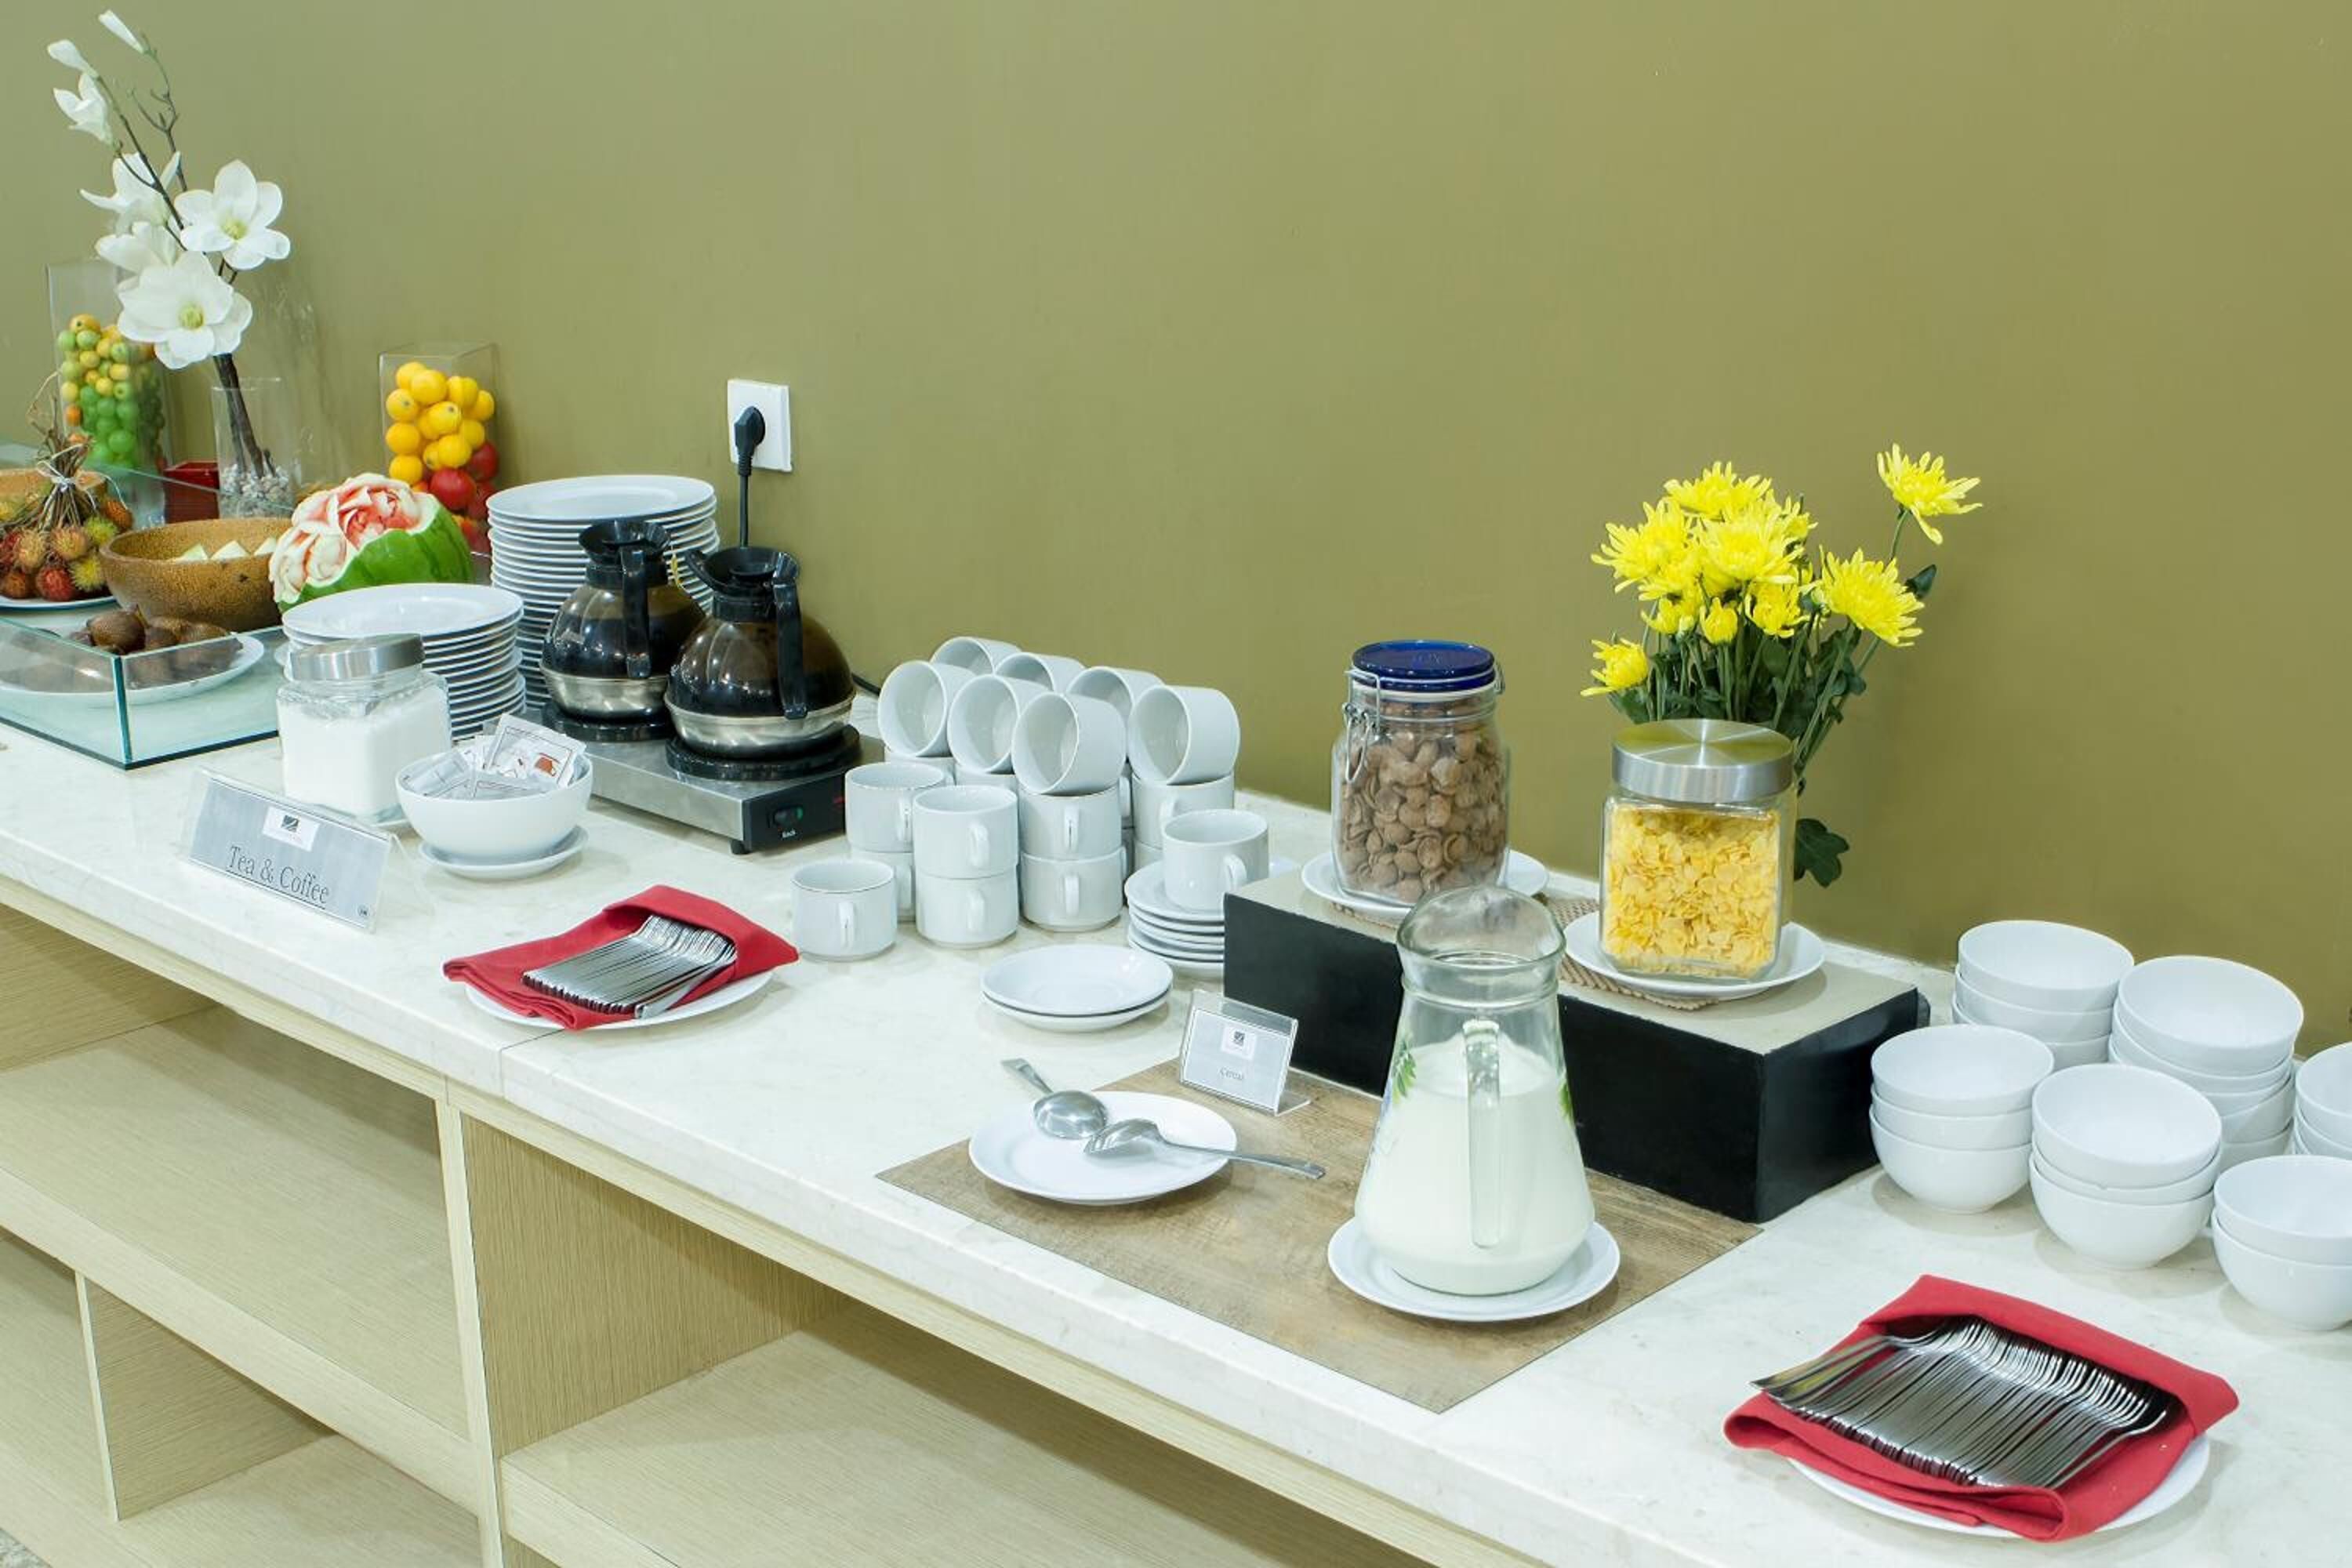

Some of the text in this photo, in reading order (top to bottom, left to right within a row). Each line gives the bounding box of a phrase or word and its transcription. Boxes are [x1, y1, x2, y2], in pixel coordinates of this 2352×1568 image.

[229, 845, 329, 904] Tea & Coffee
